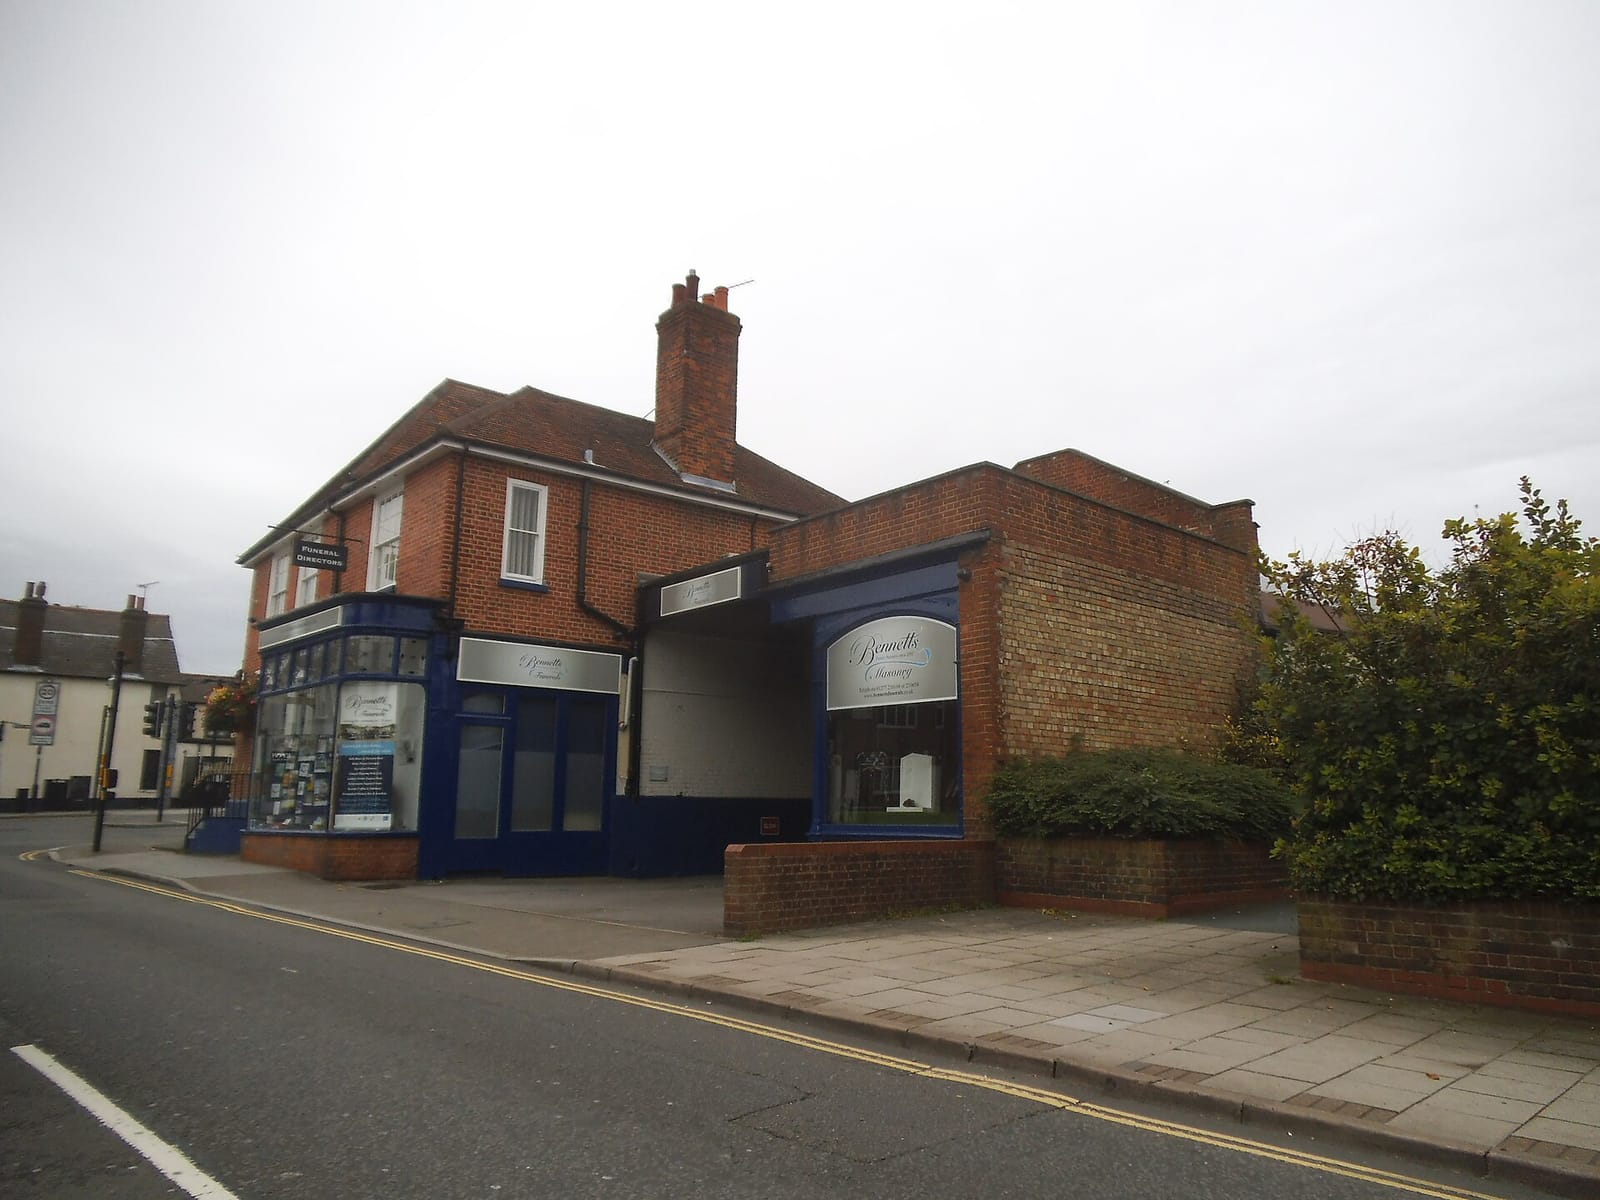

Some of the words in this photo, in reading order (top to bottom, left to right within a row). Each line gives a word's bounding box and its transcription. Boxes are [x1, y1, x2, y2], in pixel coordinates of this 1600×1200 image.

[302, 546, 340, 557] FUNERAL
[297, 554, 343, 566] DIRECTORS
[849, 631, 919, 666] Bennetts
[869, 666, 913, 680] Masonry
